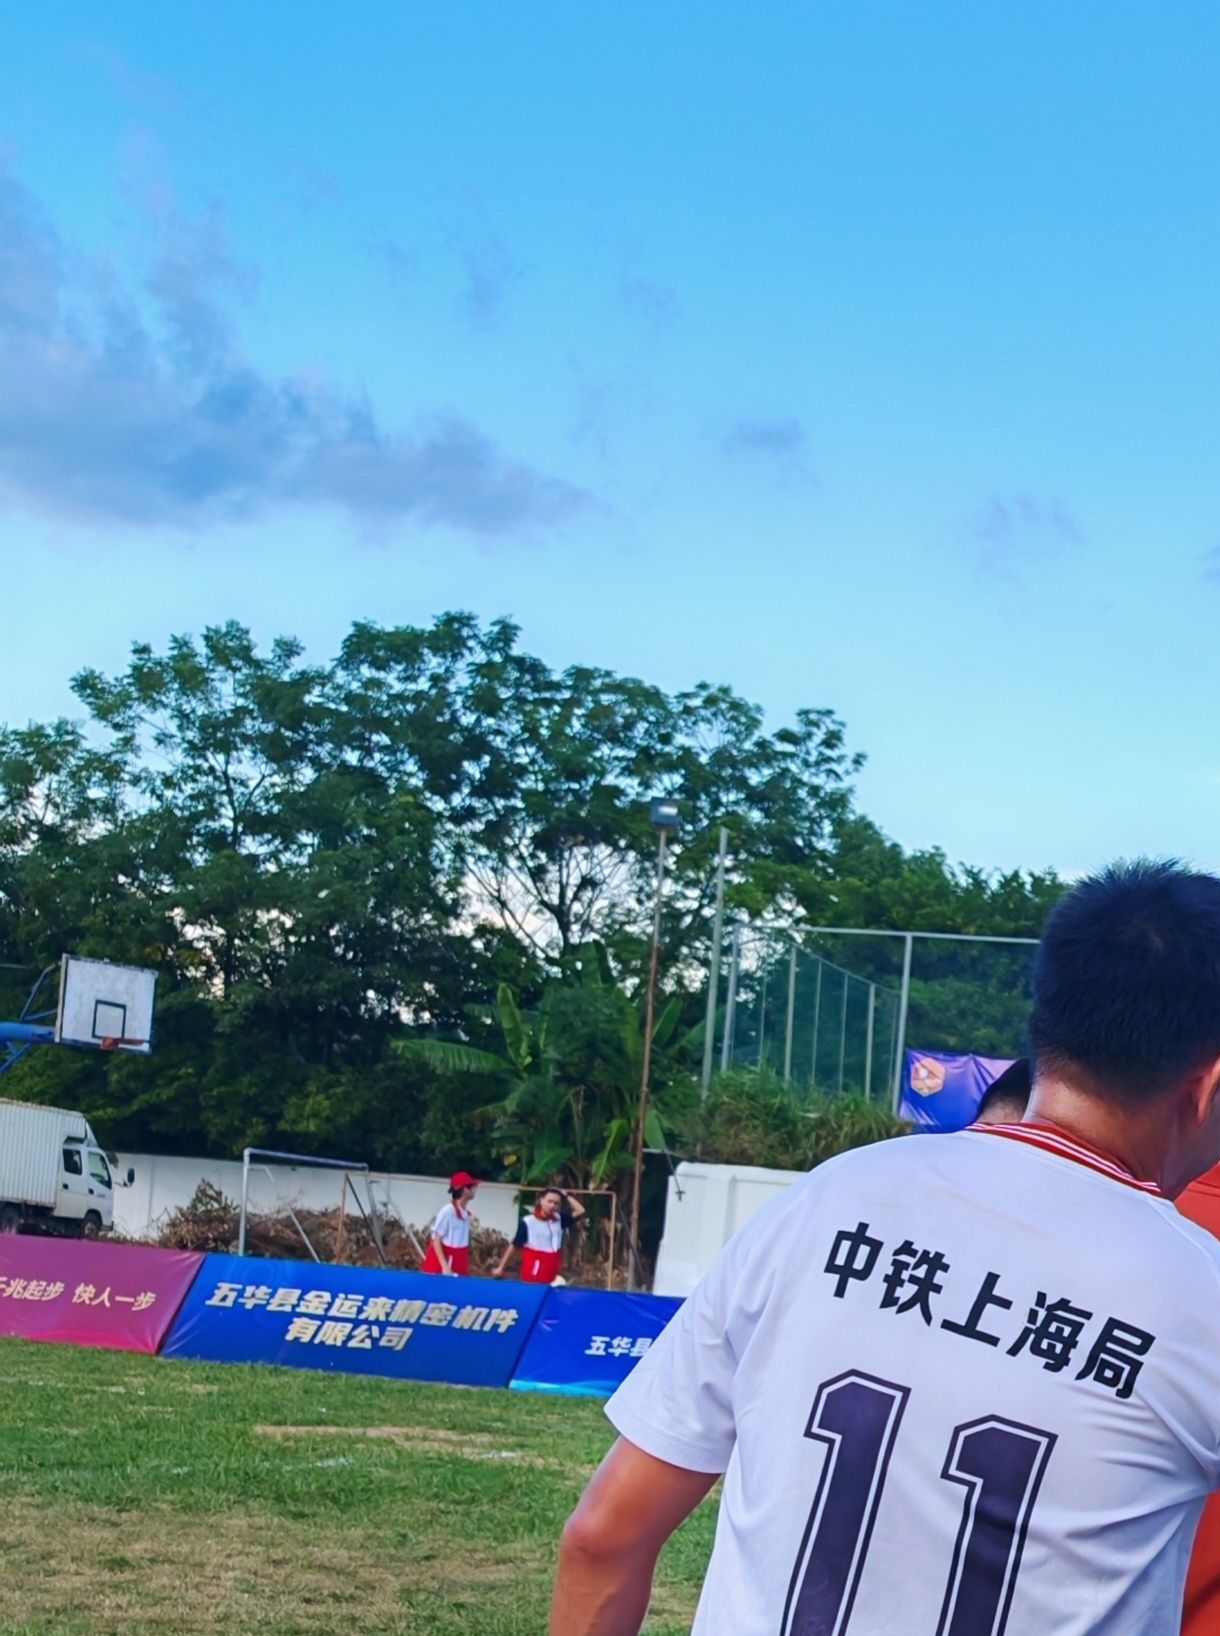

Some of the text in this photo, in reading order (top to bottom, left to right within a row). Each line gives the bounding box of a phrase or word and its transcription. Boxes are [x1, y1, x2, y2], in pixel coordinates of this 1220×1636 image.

[72, 1282, 157, 1311] 快人一步
[204, 1282, 519, 1333] 五华县金运来精密机件
[823, 1221, 1157, 1400] 中铁上海局
[284, 1316, 414, 1351] 有限公司
[584, 1335, 654, 1358] 五华县
